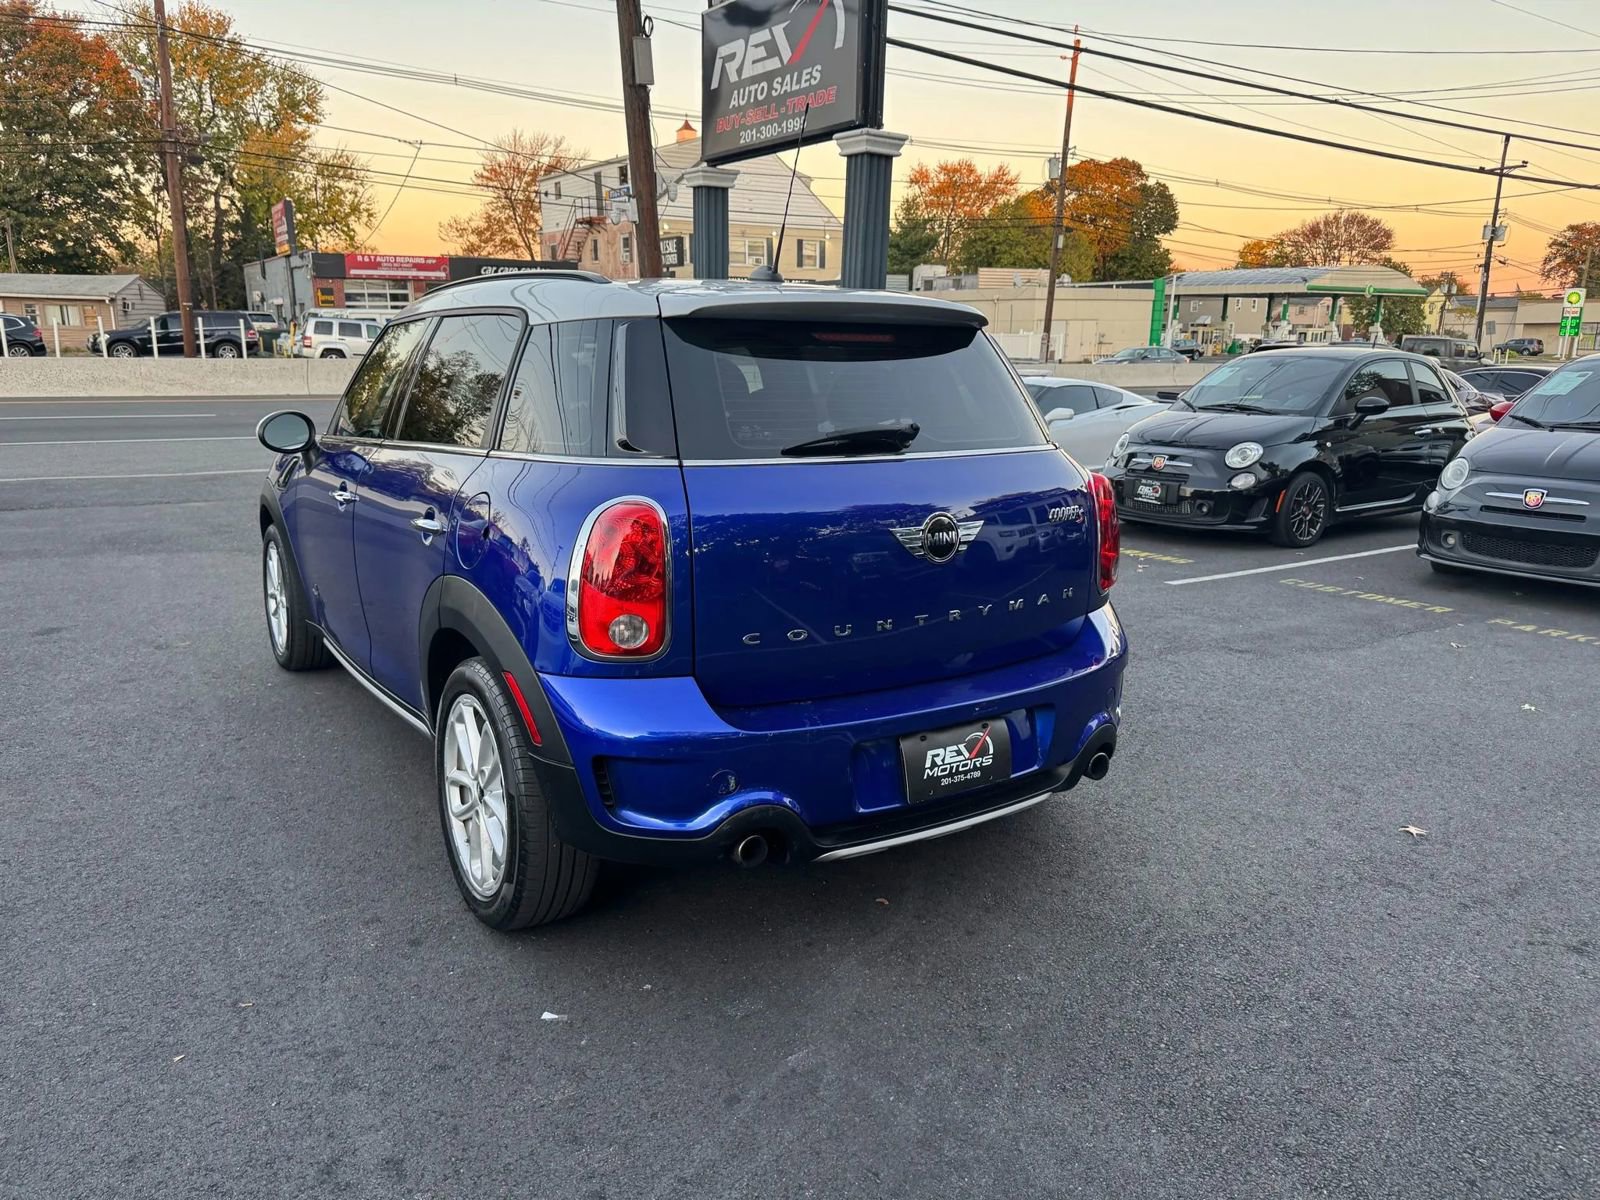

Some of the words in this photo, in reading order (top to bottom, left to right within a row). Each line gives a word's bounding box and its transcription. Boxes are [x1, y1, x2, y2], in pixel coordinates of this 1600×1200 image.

[729, 82, 768, 109] AUTO
[771, 65, 821, 96] SALES
[376, 255, 395, 264] AUTO
[396, 256, 425, 265] REPAIRS
[481, 265, 497, 275] car
[927, 530, 956, 546] MINI
[1279, 578, 1455, 613] CUSTOMER
[742, 587, 1073, 645] COUNTRYMAN
[925, 733, 985, 768] REV
[924, 755, 993, 780] MOTORS
[940, 770, 981, 786] 201-375-4789
